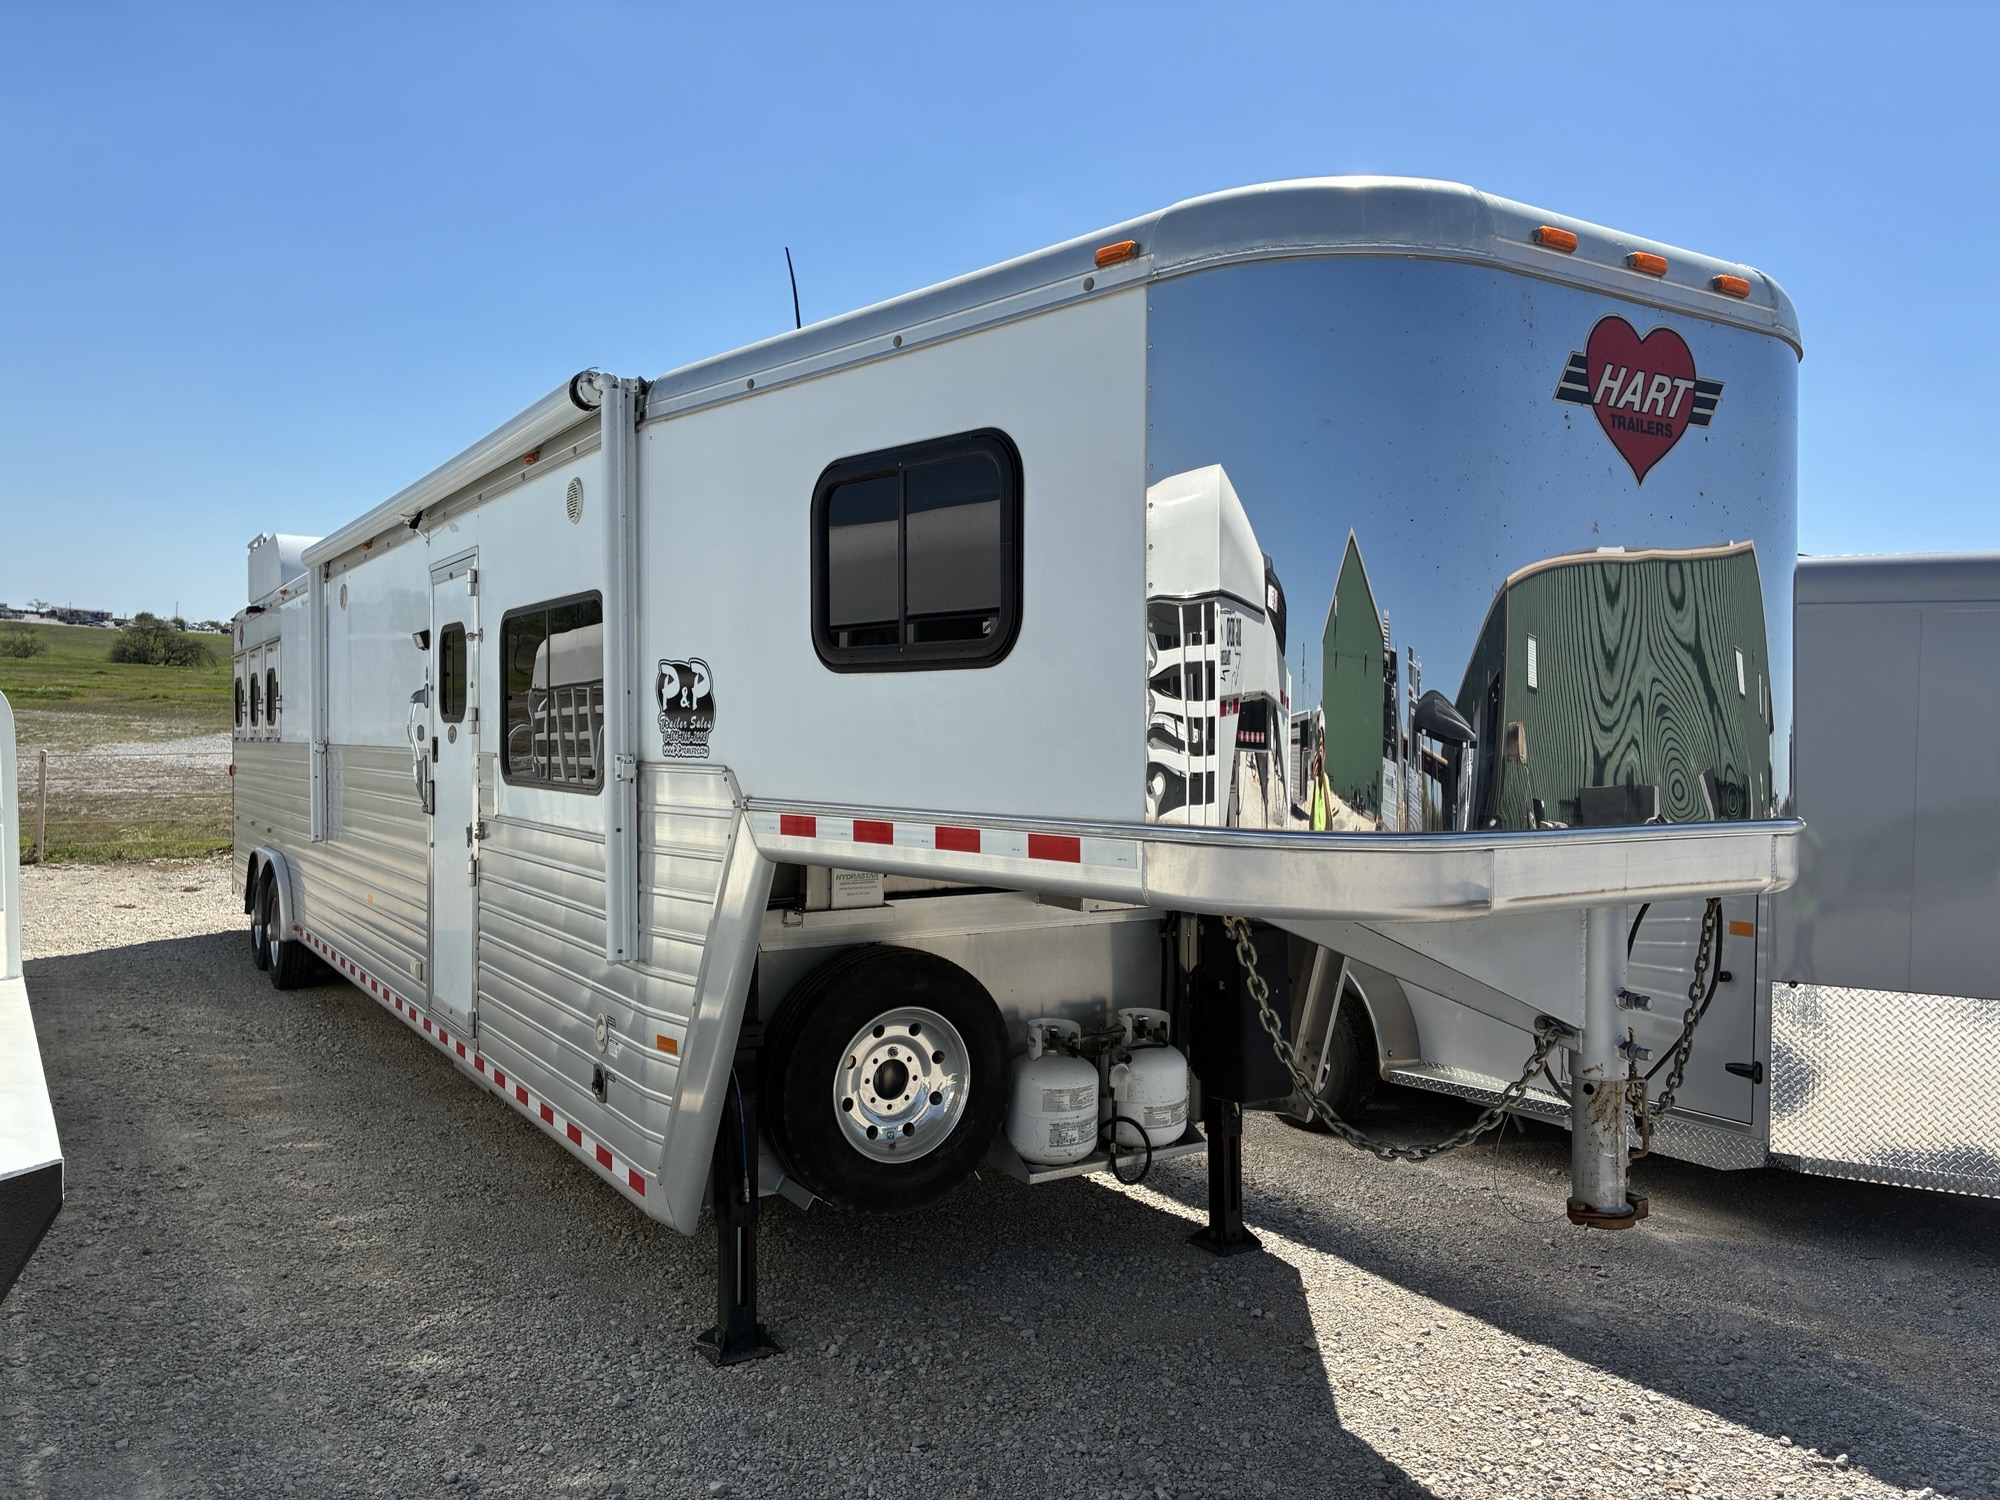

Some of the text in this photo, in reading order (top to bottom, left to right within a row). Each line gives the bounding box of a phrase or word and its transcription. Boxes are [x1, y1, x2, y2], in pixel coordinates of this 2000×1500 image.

[1593, 363, 1695, 419] HART
[1610, 413, 1674, 438] TRAILERS
[659, 716, 712, 731] Trailer Sales
[836, 872, 879, 881] HYDRASTAR
